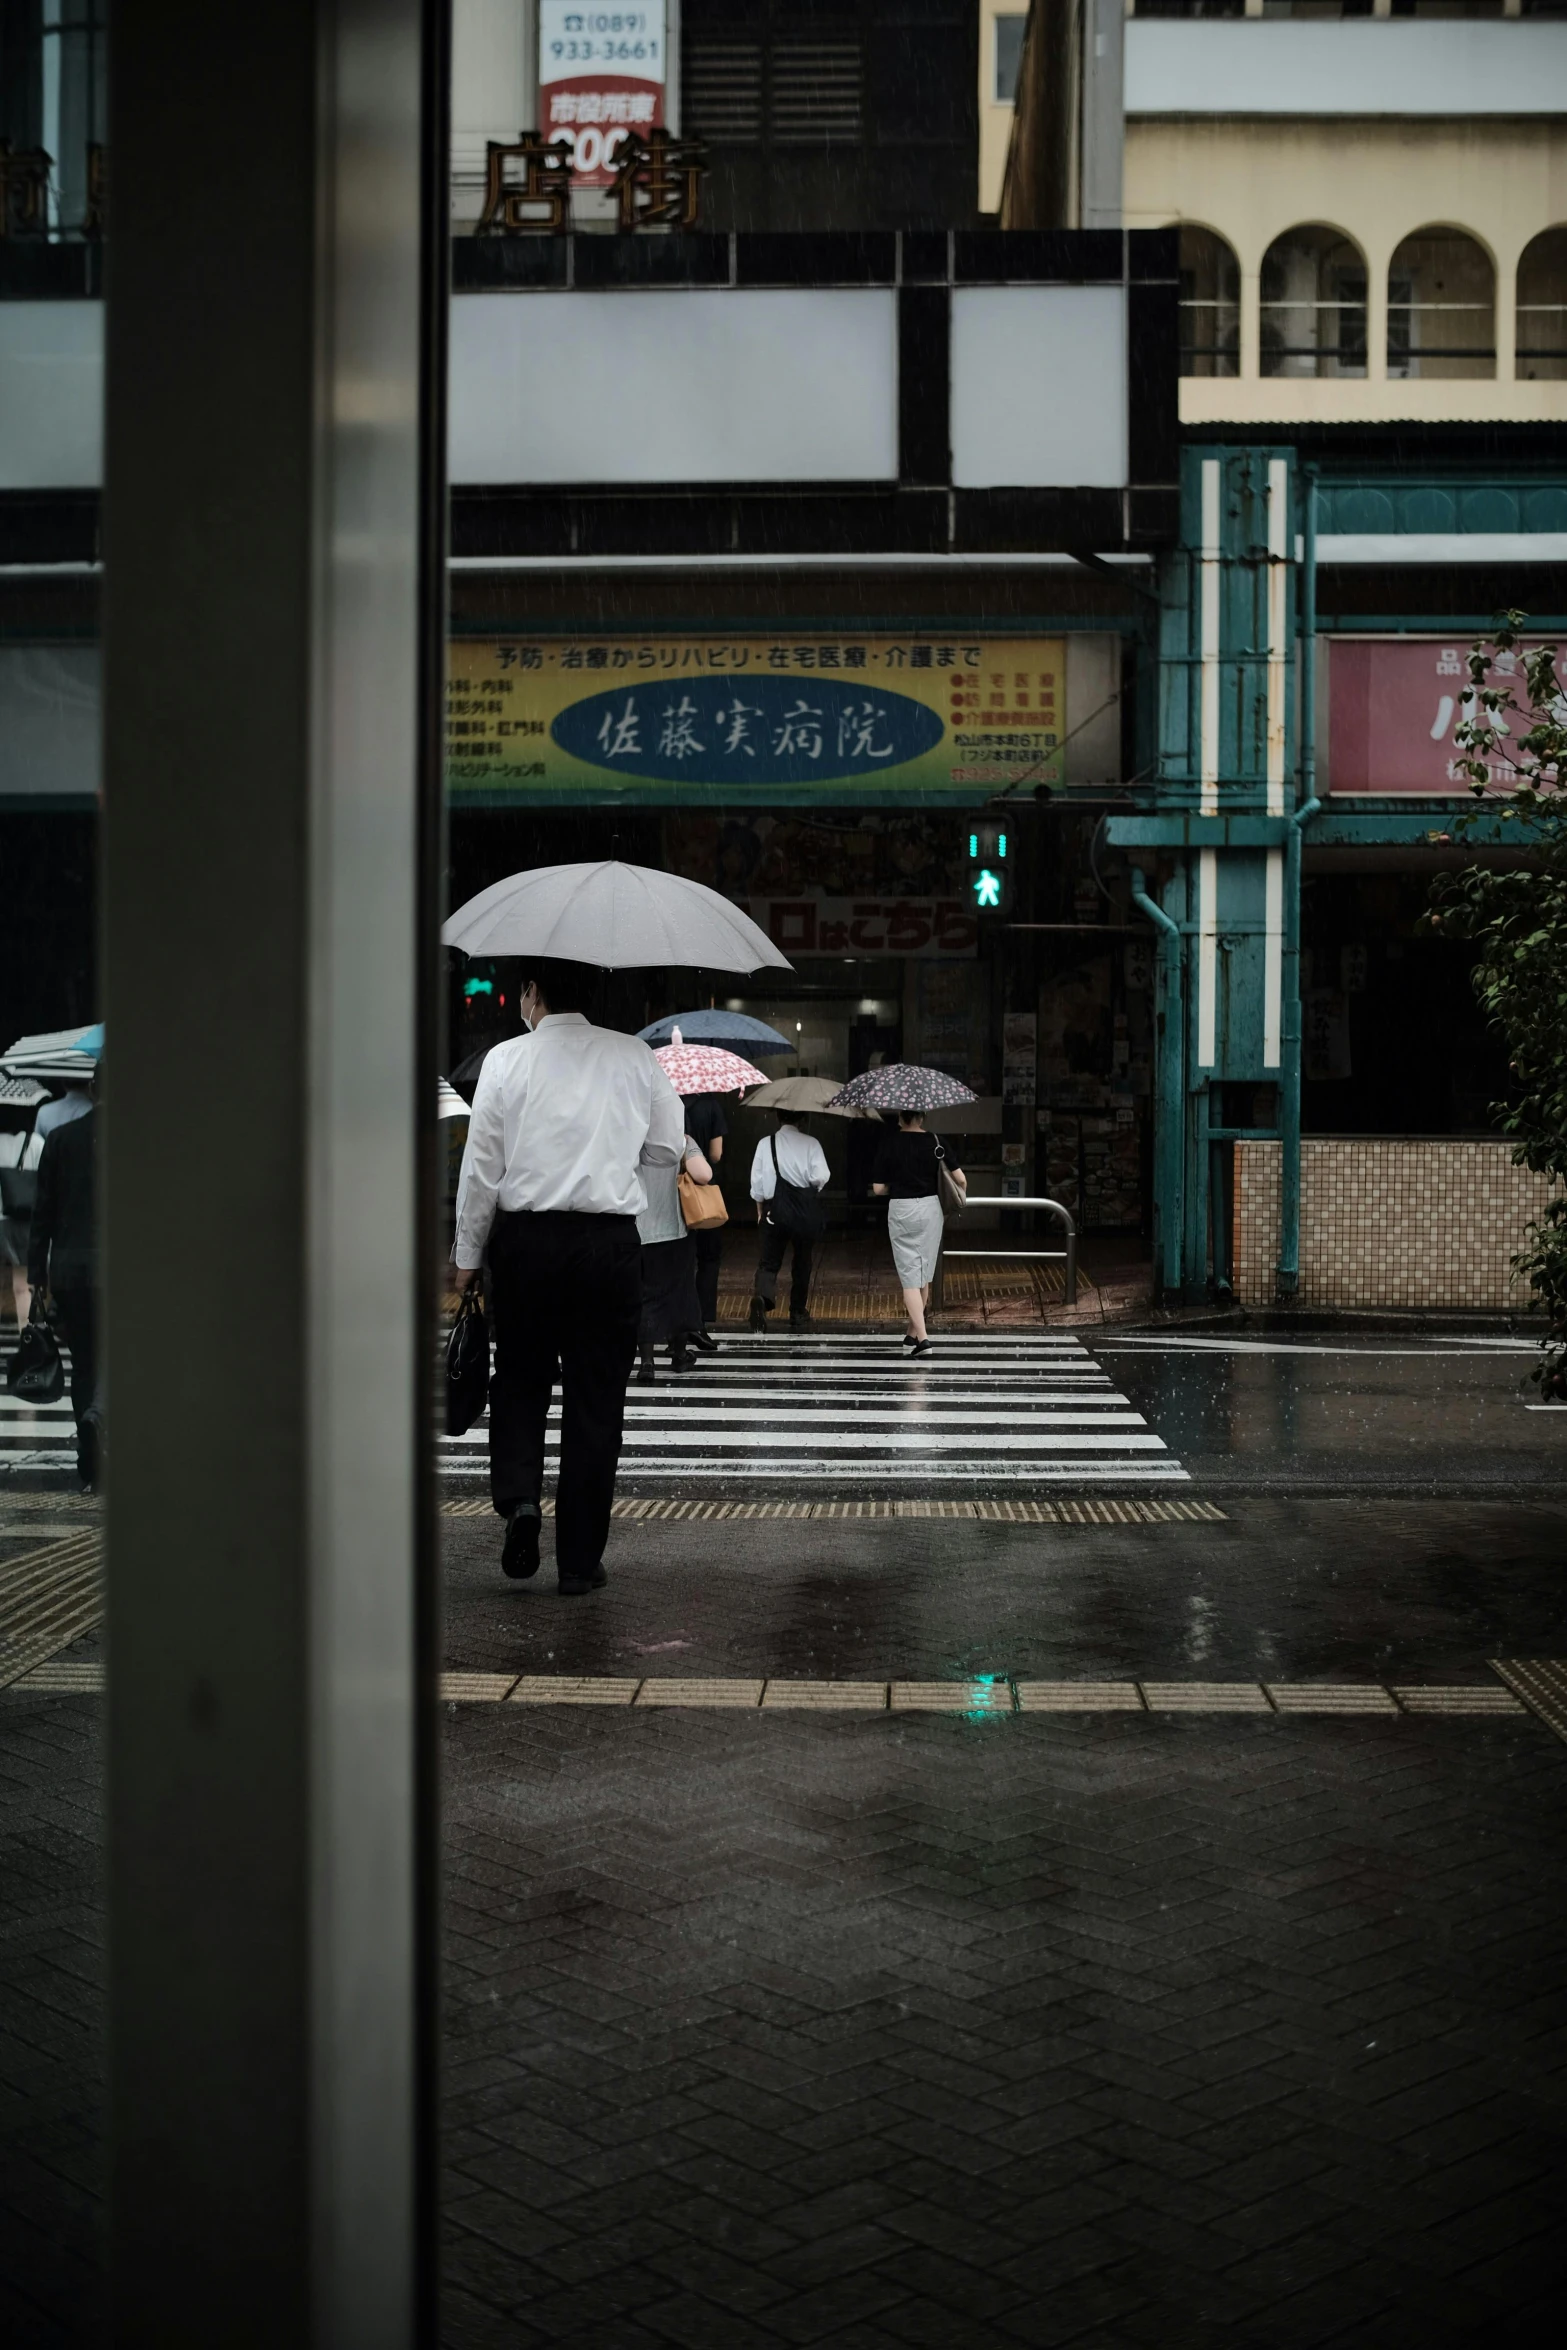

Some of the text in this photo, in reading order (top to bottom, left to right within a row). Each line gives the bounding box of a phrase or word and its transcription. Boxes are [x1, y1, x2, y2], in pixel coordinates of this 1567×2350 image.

[588, 13, 646, 33] (089)
[550, 41, 659, 61] 933-3661
[496, 646, 981, 670] 予防・治療からリハビリ・在宅医療・介護まで
[597, 696, 894, 760] 佐藤実病院
[447, 763, 545, 777] ハビリテーション科
[736, 901, 977, 950] 口はこちら
